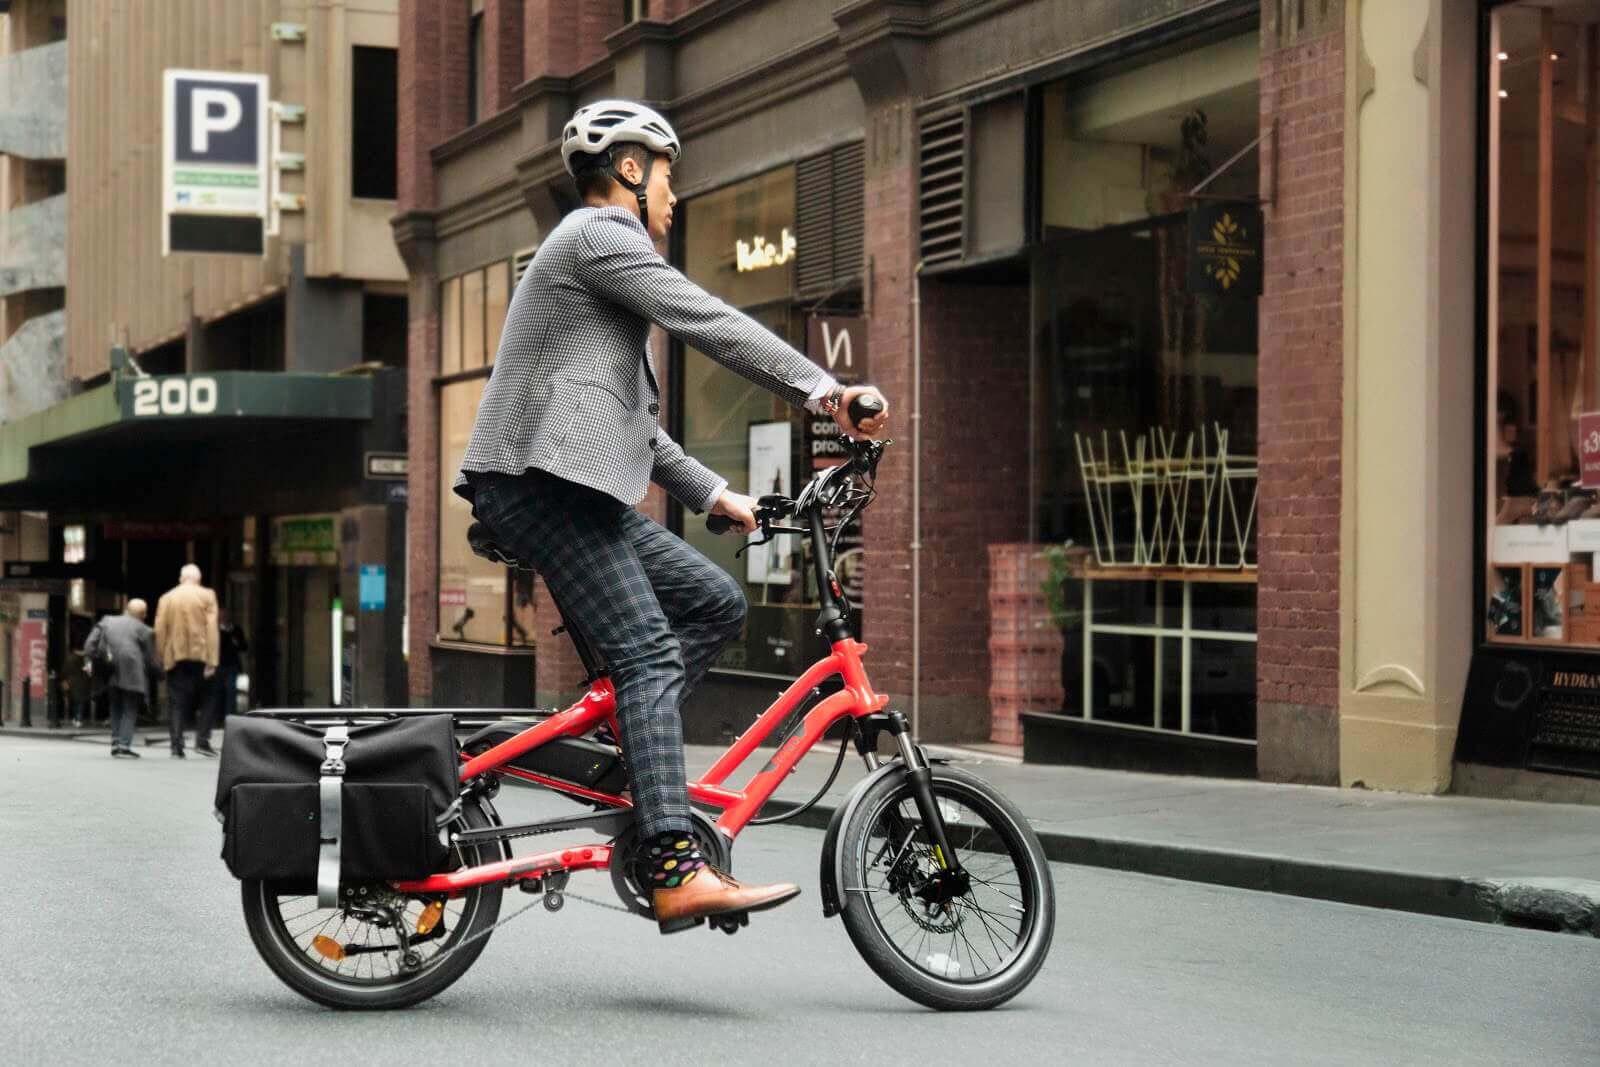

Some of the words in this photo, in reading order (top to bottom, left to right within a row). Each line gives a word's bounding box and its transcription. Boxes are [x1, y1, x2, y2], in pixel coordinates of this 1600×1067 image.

[190, 88, 243, 153] P
[134, 377, 217, 415] 200
[1584, 430, 1600, 454] $3
